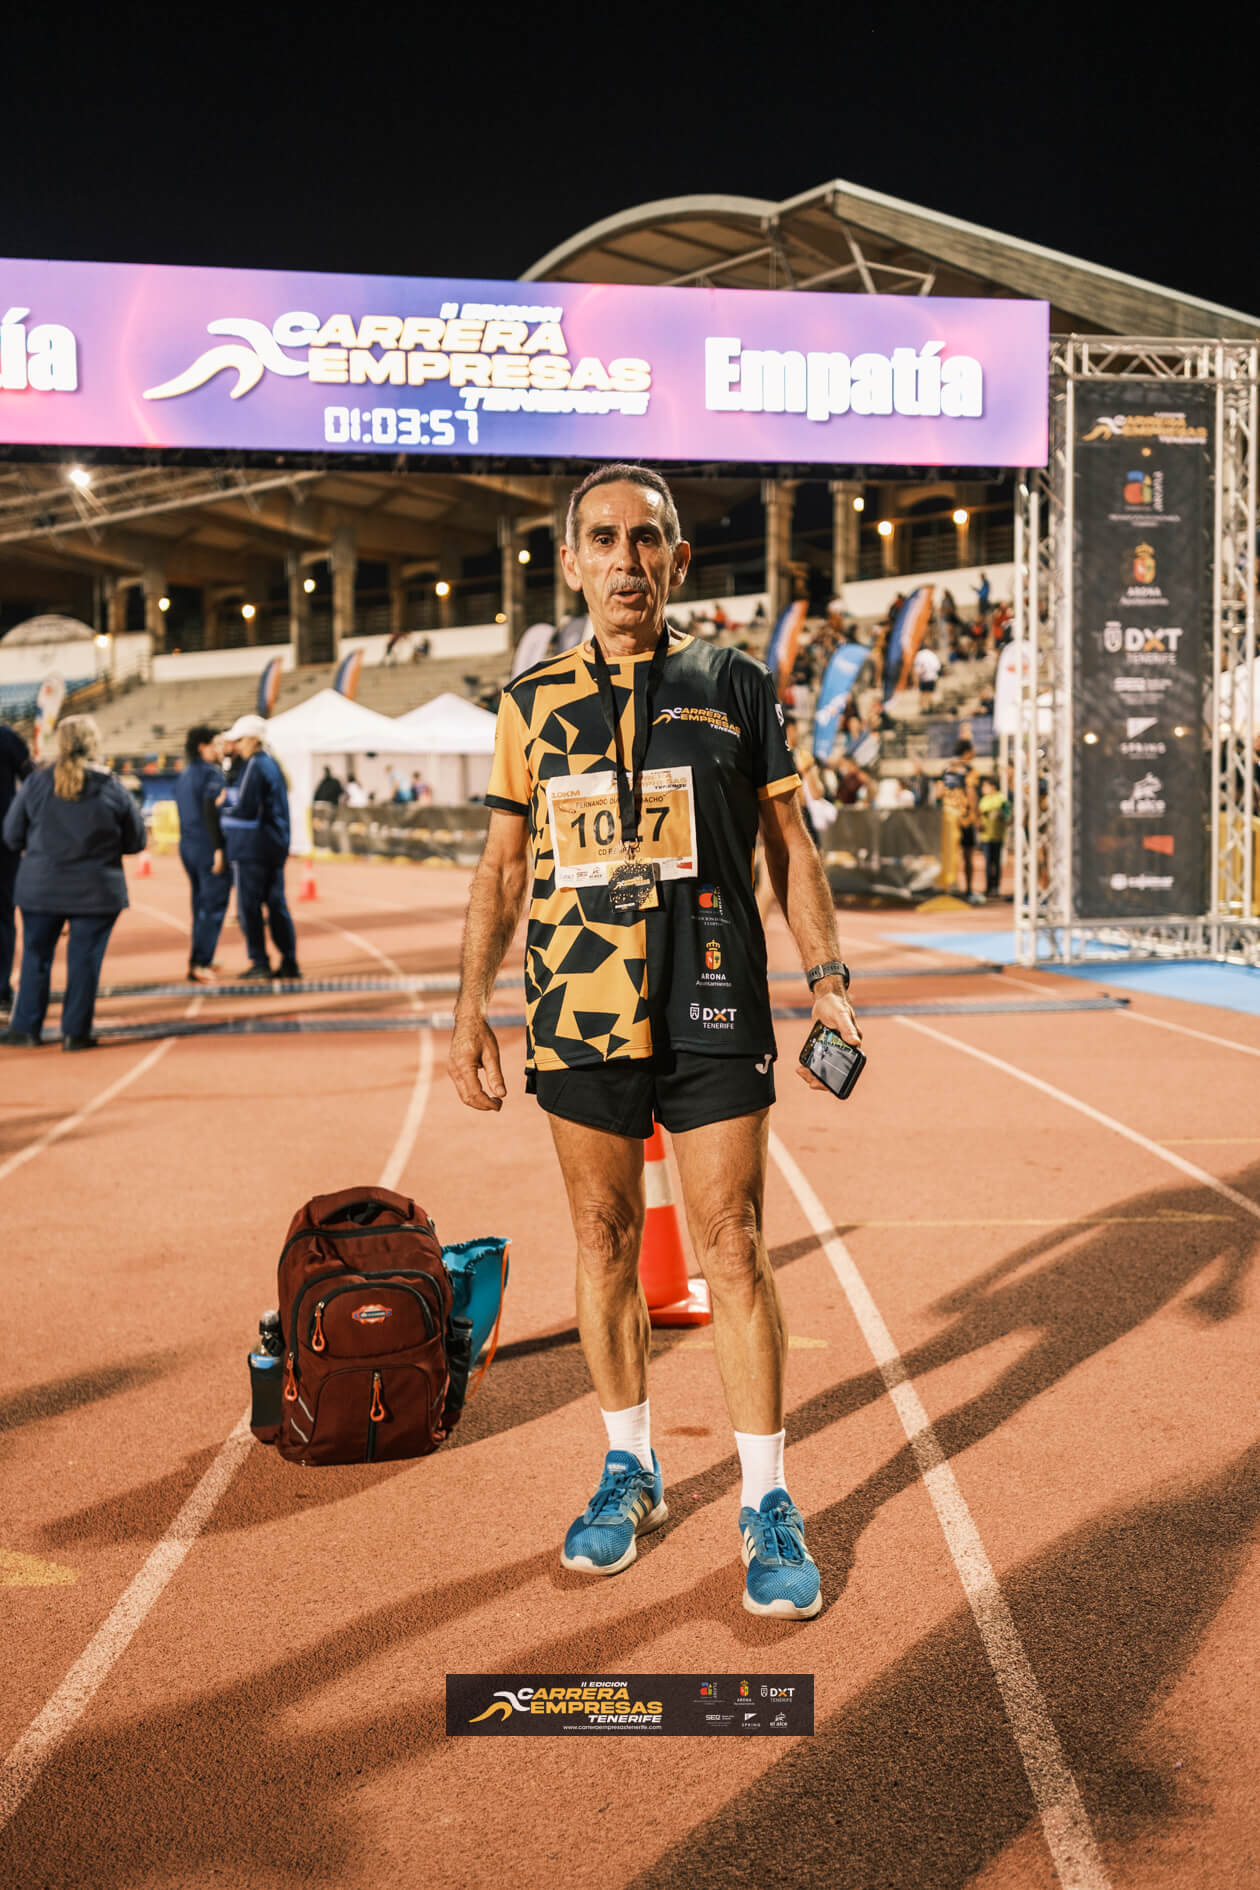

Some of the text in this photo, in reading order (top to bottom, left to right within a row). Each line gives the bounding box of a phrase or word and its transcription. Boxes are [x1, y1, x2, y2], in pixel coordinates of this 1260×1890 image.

[272, 311, 568, 355] CARRERA
[308, 348, 652, 392] EMPRESAS
[705, 336, 983, 422] Empatía
[323, 406, 479, 445] 01:03:57
[1124, 627, 1184, 652] DXT
[673, 706, 728, 722] CARRERA
[680, 713, 741, 733] EMPRESAS
[571, 806, 670, 848] 107
[701, 972, 727, 980] ARONA
[702, 1007, 737, 1022] DXT
[703, 1022, 735, 1030] TENERIFE
